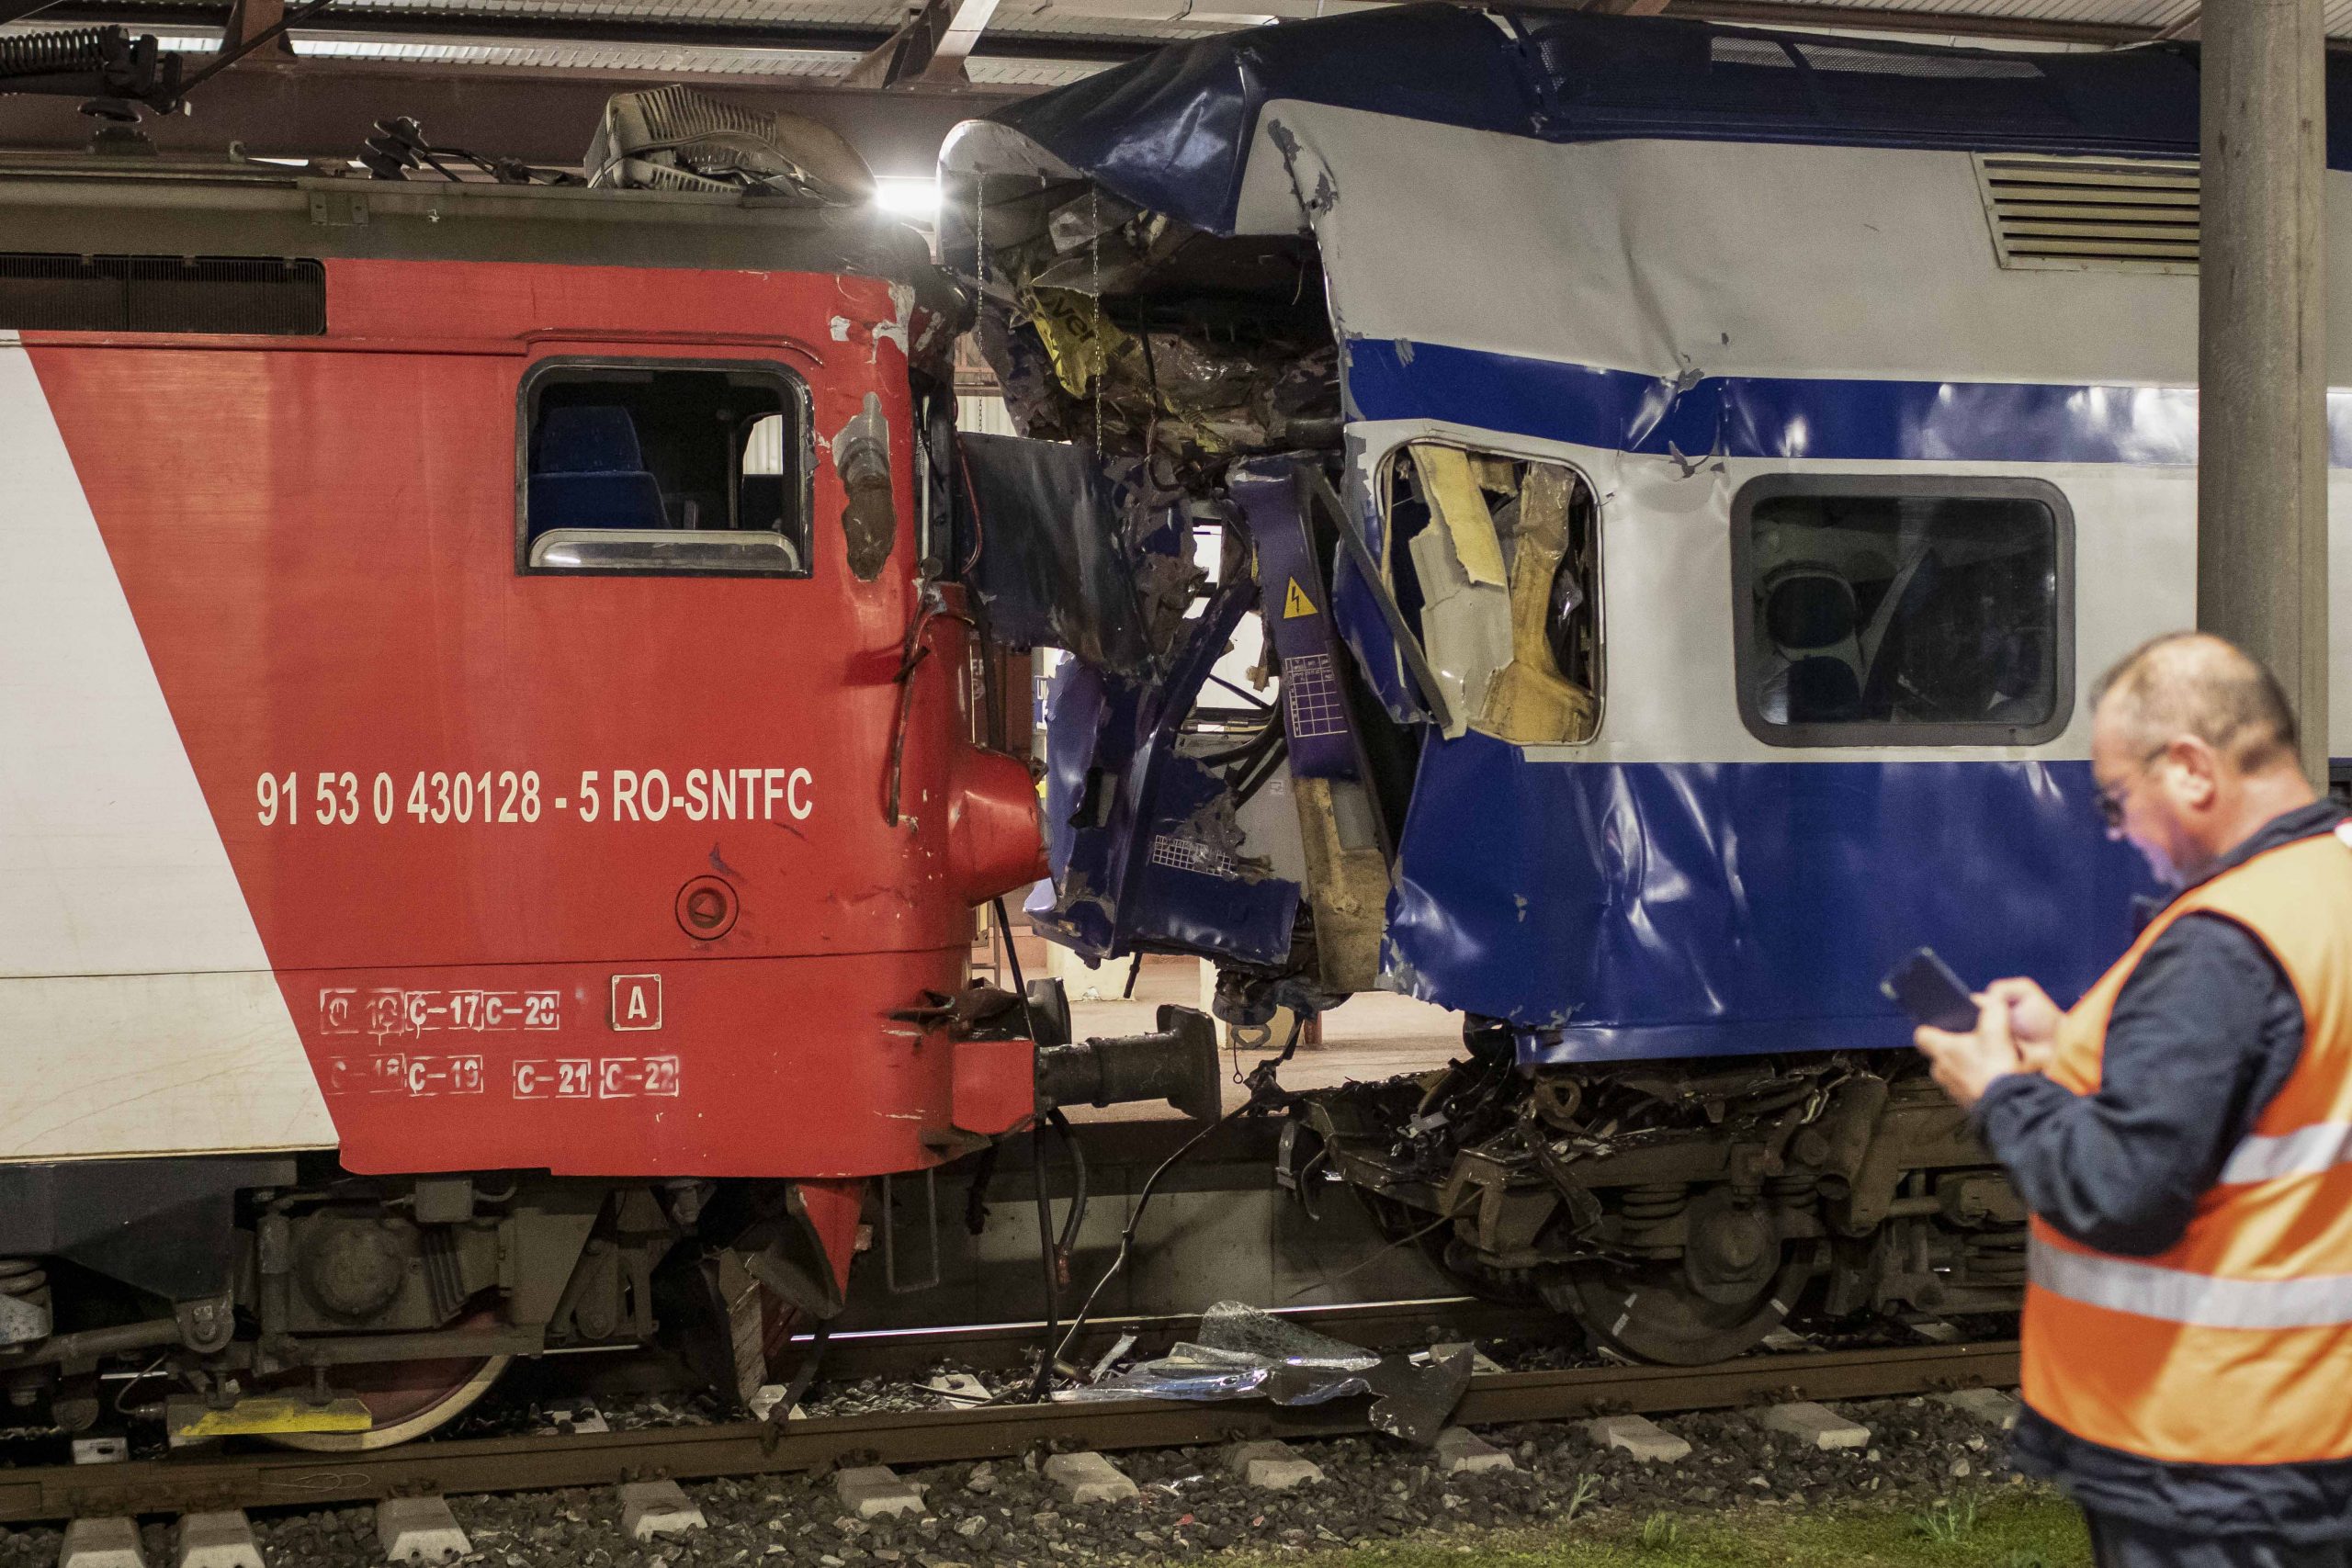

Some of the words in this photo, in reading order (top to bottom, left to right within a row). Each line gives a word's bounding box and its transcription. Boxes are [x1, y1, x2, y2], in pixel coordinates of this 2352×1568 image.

[257, 772, 297, 826] 91
[316, 772, 359, 825] 53
[373, 772, 393, 824] 0
[407, 770, 540, 823] 430128
[555, 797, 567, 808] -
[579, 771, 599, 822] 5
[614, 767, 812, 821] RO-SNTFC
[410, 995, 479, 1026] C-17
[486, 997, 555, 1025] C-20
[628, 986, 648, 1019] A
[409, 1059, 478, 1091] C-19
[518, 1064, 587, 1093] C-21
[605, 1063, 674, 1091] C-22
